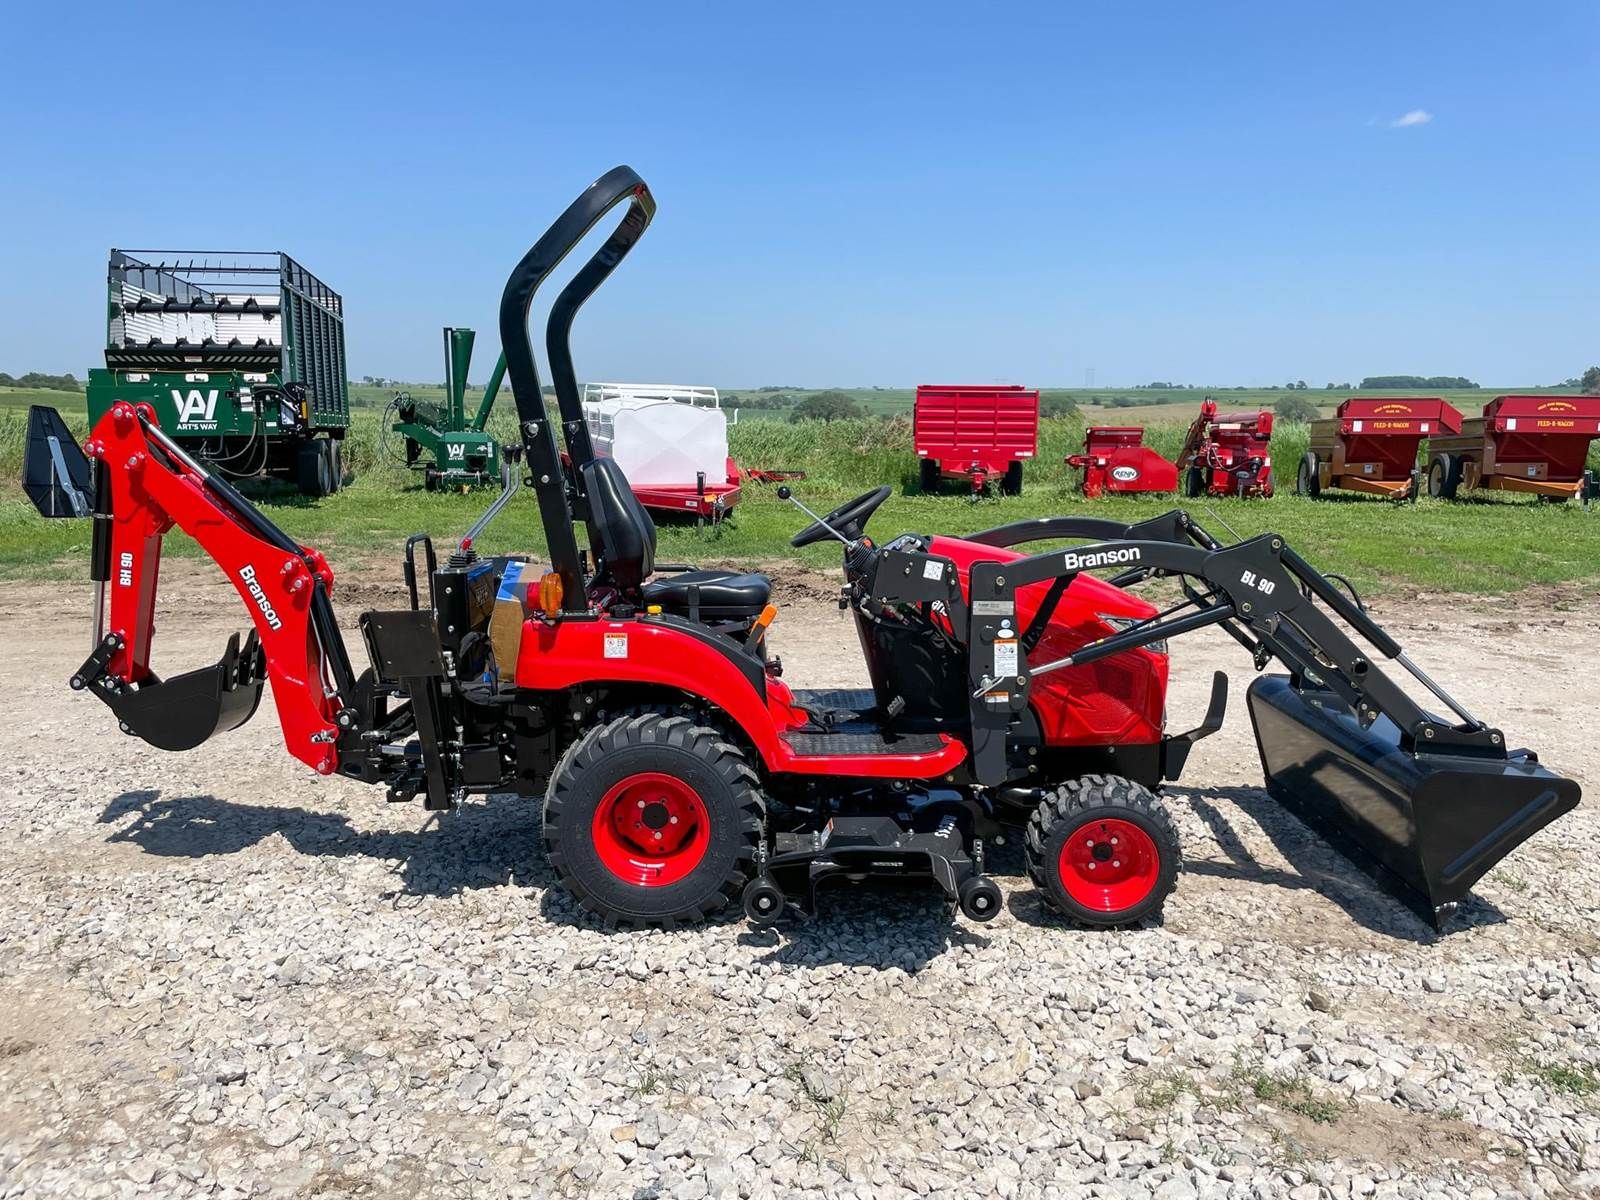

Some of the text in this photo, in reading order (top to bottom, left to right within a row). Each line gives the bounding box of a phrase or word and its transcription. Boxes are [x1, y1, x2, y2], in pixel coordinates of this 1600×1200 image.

[176, 423, 218, 431] ART'S WAY
[1114, 470, 1135, 479] RENN
[120, 552, 133, 587] BH 90
[1064, 547, 1141, 570] Branson
[1240, 570, 1276, 595] BL 90
[239, 564, 283, 631] Branson
